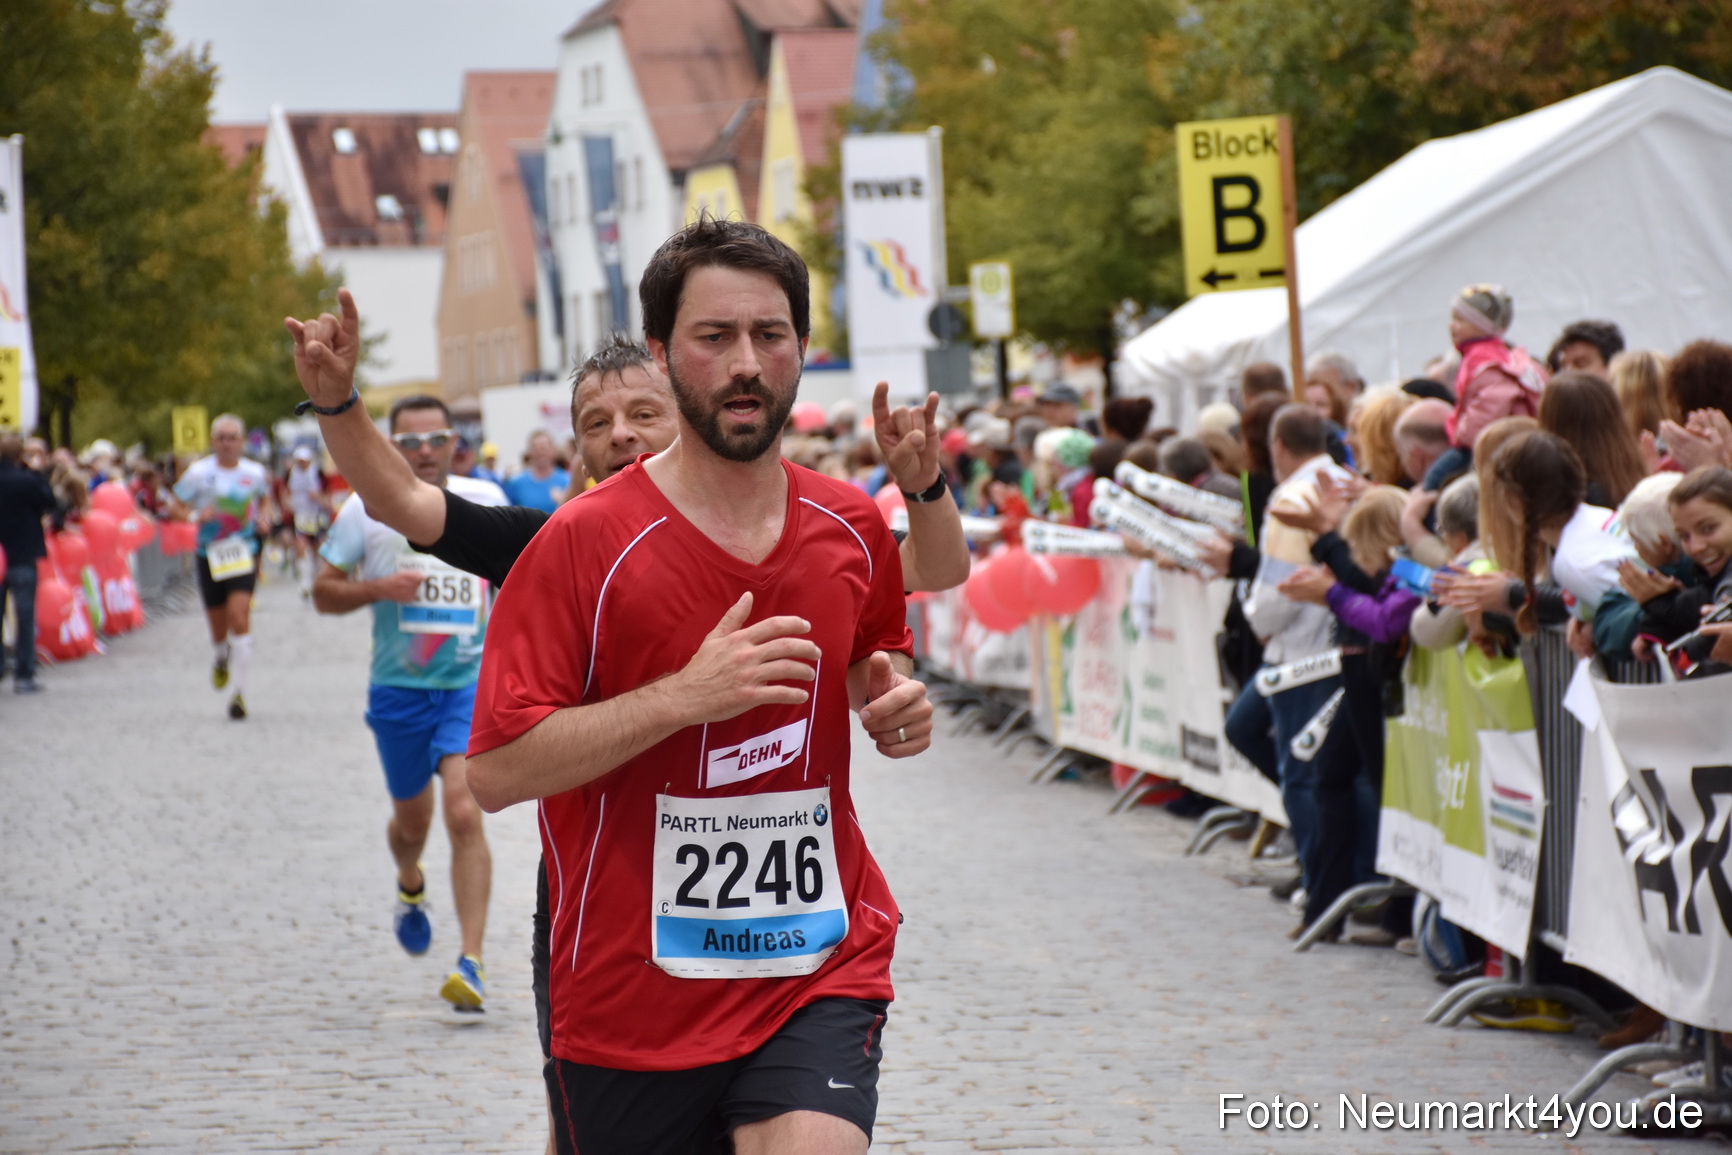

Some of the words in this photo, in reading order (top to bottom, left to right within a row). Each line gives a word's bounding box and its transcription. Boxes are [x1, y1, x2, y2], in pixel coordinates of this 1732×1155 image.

[1192, 126, 1278, 160] Block
[1212, 174, 1267, 255] B
[413, 576, 472, 604] 658
[737, 740, 783, 771] DEHN
[660, 813, 723, 834] PARTL
[726, 810, 809, 832] Neumarkt
[675, 835, 824, 910] 2246
[660, 901, 670, 914] C
[702, 927, 807, 953] Andreas
